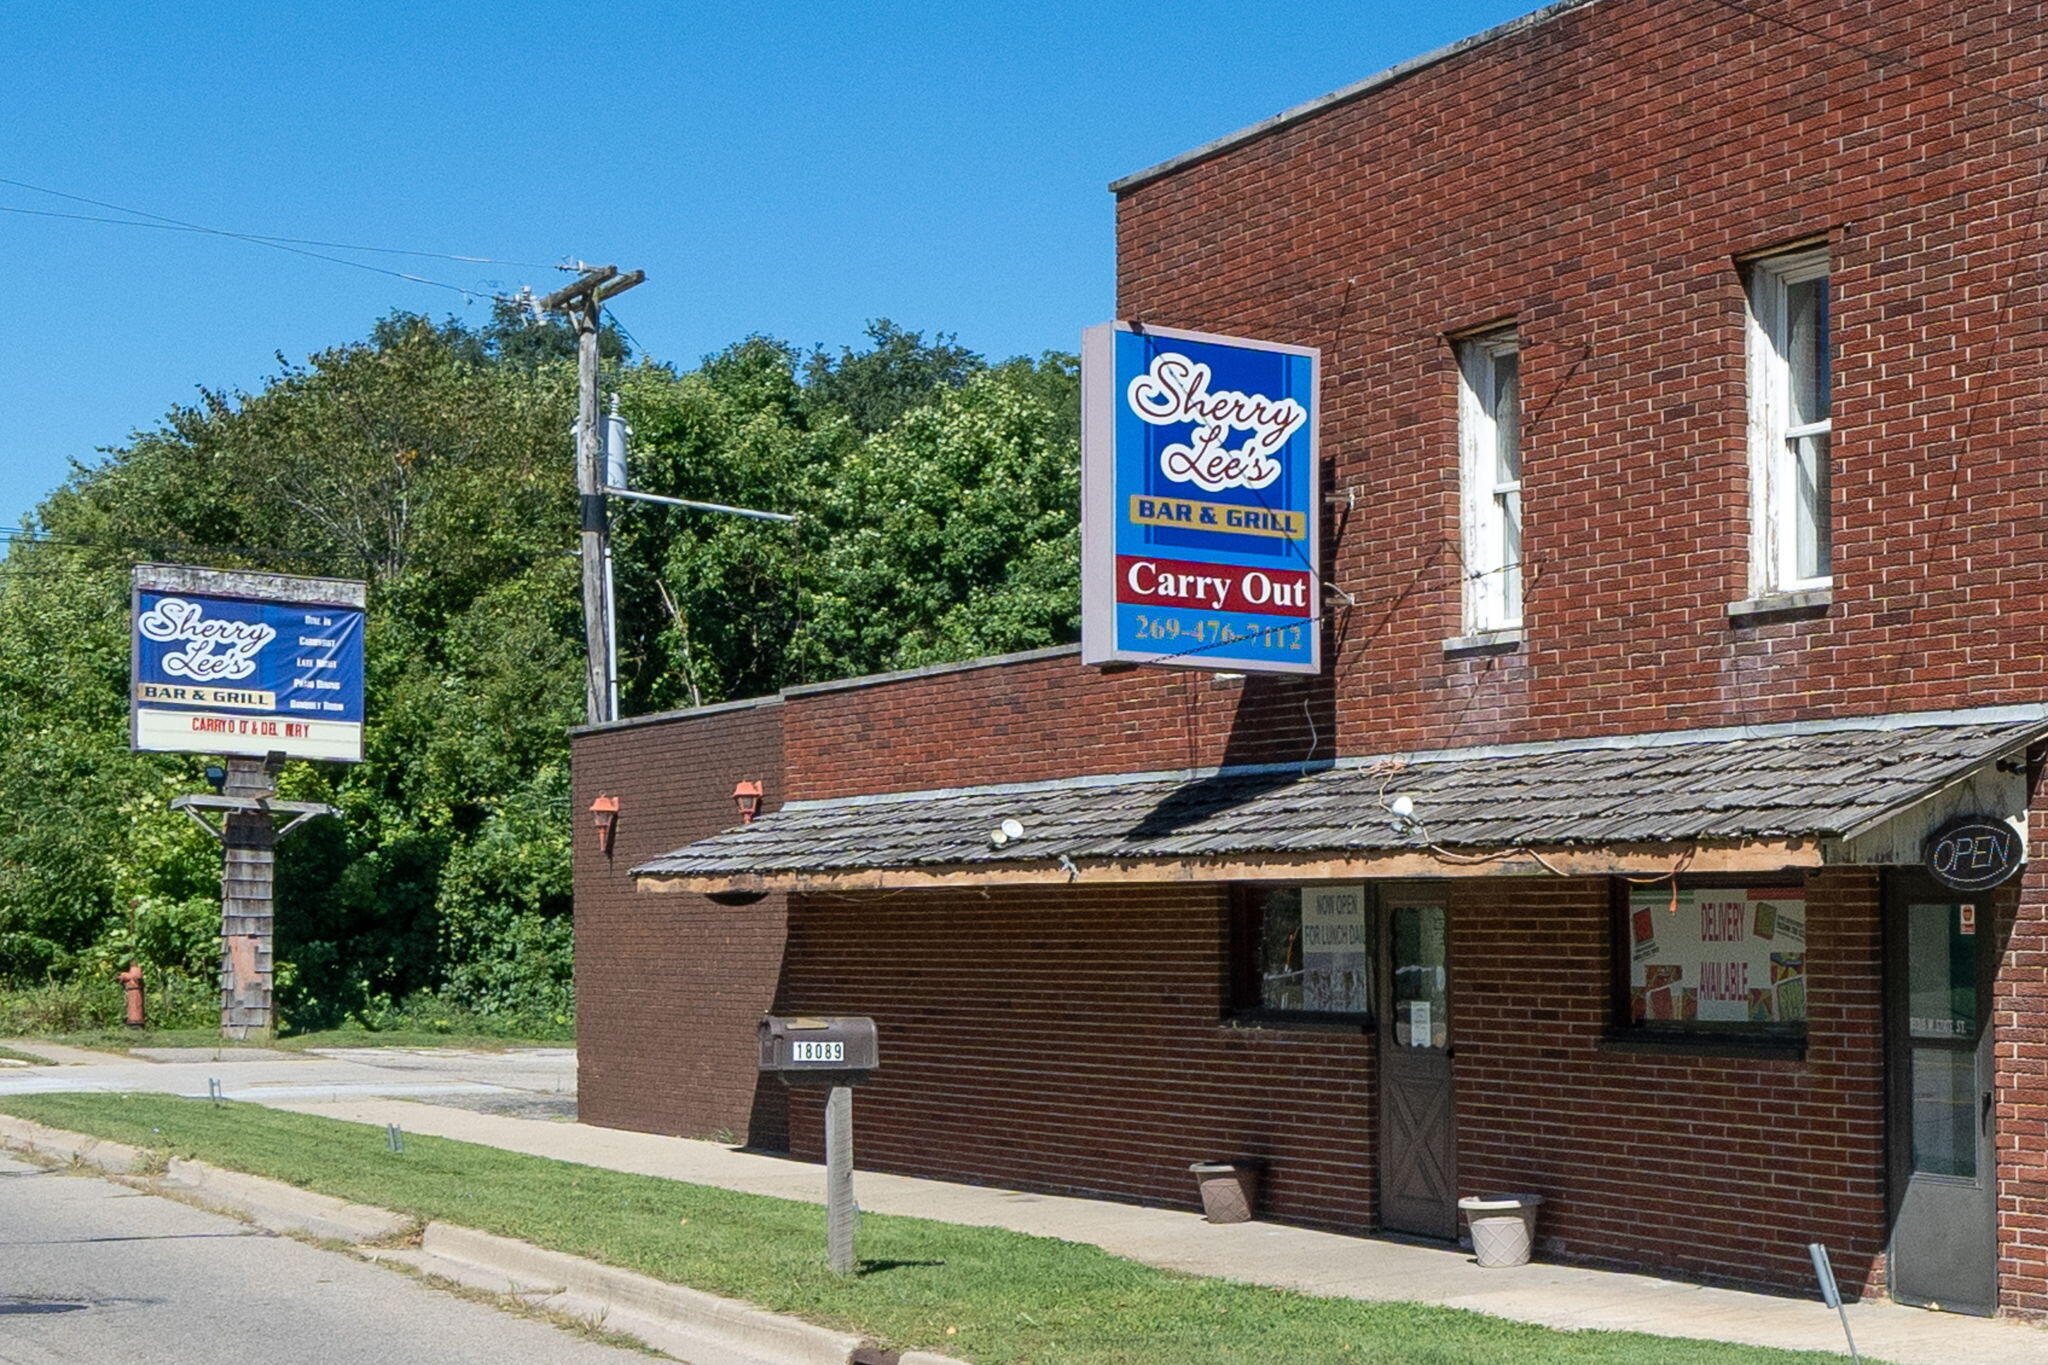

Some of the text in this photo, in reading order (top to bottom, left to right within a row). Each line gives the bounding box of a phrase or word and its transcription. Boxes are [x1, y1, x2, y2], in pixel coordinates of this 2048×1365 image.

[1134, 359, 1303, 448] Sherry
[1167, 424, 1277, 486] Lee's
[1138, 500, 1298, 534] BAR & GRILL
[1128, 561, 1306, 609] Carry Out
[141, 600, 272, 654] Sherry
[1135, 614, 1301, 650] 269-476-7112
[165, 638, 253, 678] Lee's
[144, 686, 269, 706] BAR & GRILL
[1933, 834, 2012, 872] OPEN
[1316, 894, 1359, 915] NOW OPEN
[1701, 902, 1746, 942] DELIVERY
[1700, 961, 1749, 1001] AVAILABLE
[797, 1043, 842, 1060] 18089
